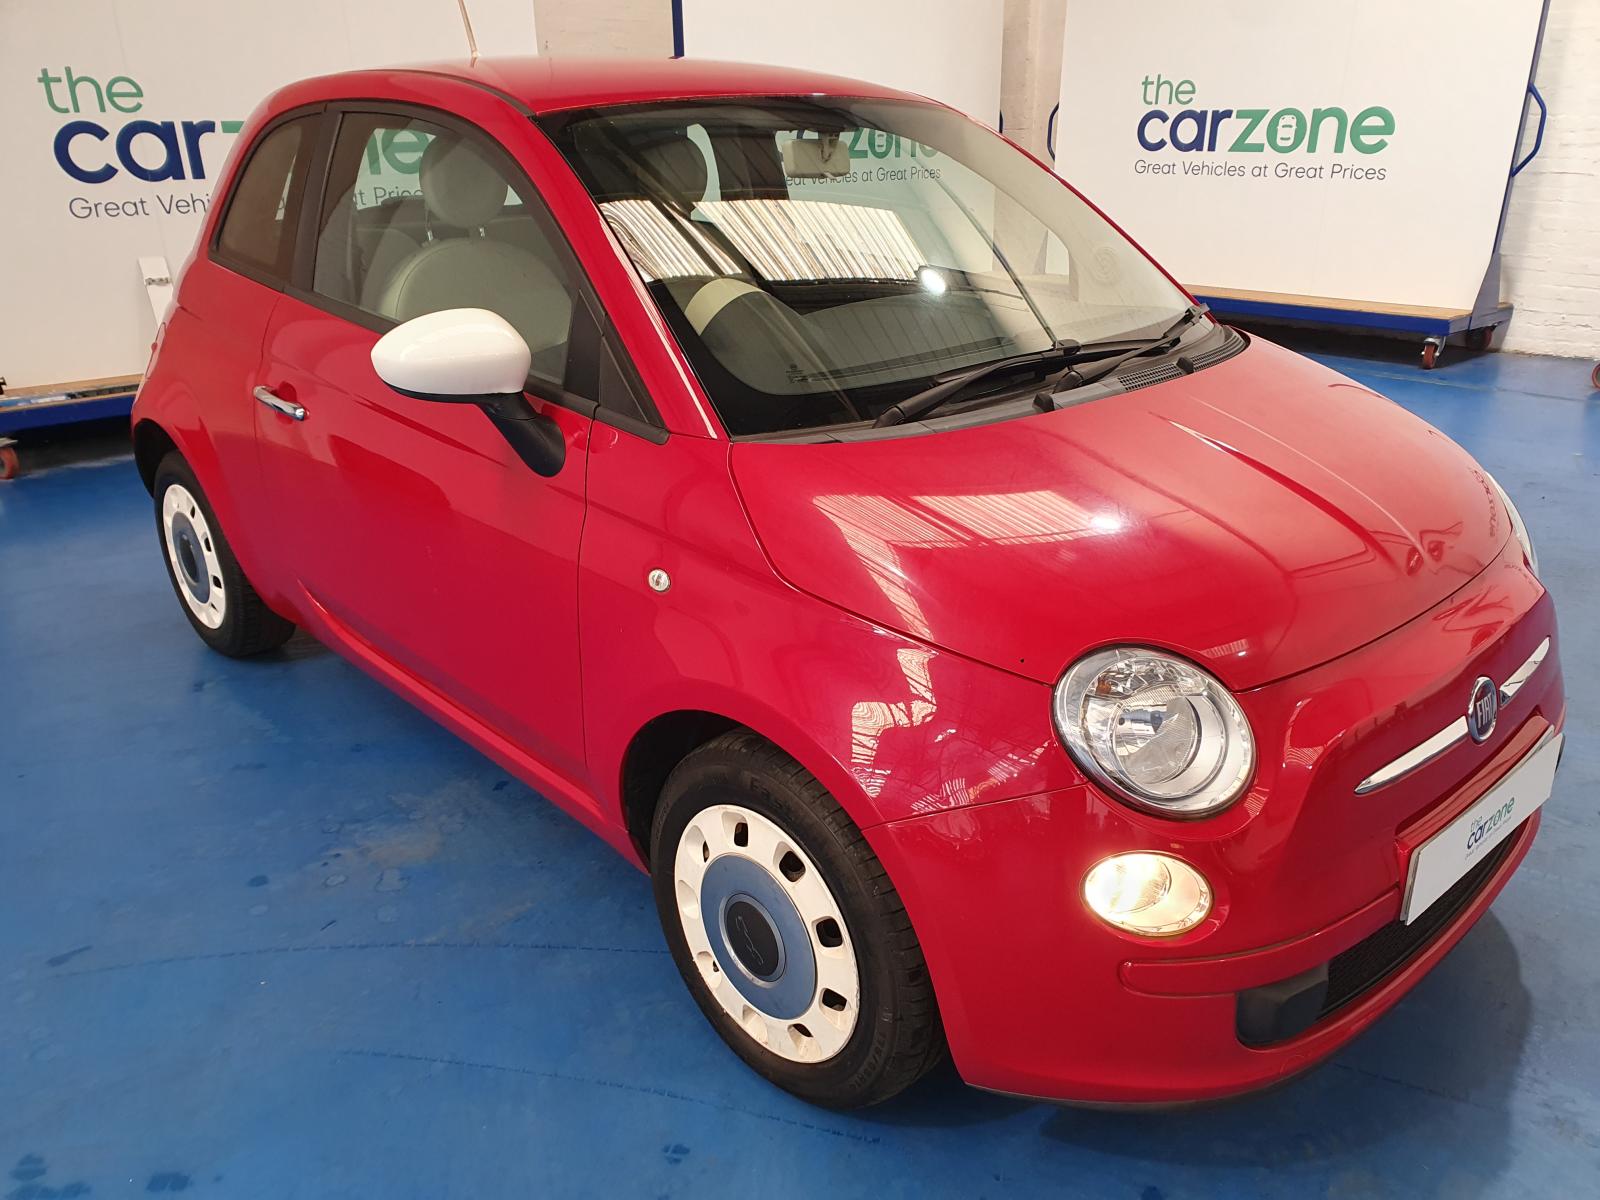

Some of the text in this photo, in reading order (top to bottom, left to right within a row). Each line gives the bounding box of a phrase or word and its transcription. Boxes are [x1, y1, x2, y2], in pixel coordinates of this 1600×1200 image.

[37, 66, 144, 114] the
[1141, 74, 1196, 105] the
[1137, 106, 1395, 155] carzone
[862, 169, 872, 182] at
[877, 167, 907, 181] Great
[911, 166, 941, 179] Prices
[1134, 159, 1387, 181] Great Vehicles at Great Prices
[69, 195, 150, 219] Great
[1476, 692, 1494, 728] FIAT
[1467, 796, 1515, 850] carzone
